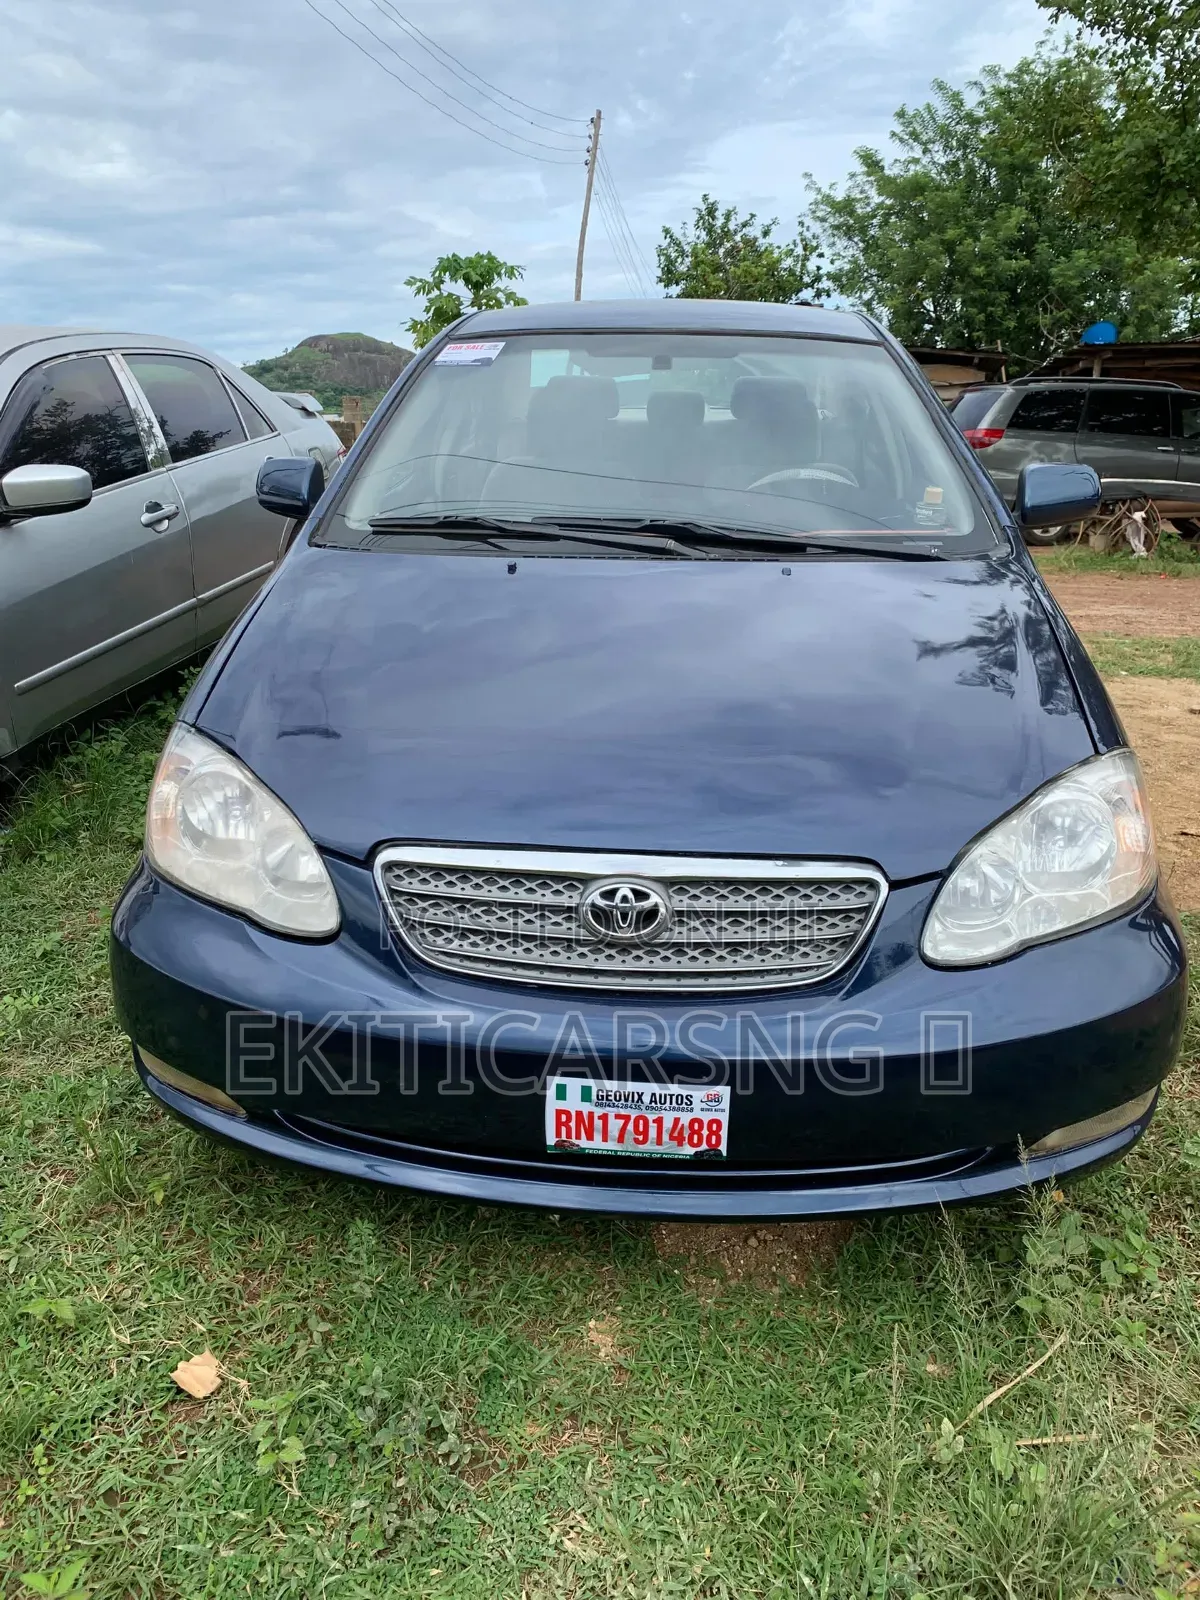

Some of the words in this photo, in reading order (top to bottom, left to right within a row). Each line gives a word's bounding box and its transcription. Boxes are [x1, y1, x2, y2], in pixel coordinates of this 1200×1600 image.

[596, 1088, 645, 1105] GEOVIX
[648, 1092, 694, 1107] AUTOS
[555, 1108, 723, 1150] RN1791488
[585, 1148, 616, 1156] FEDERAL
[617, 1150, 651, 1158] REPUBLIC
